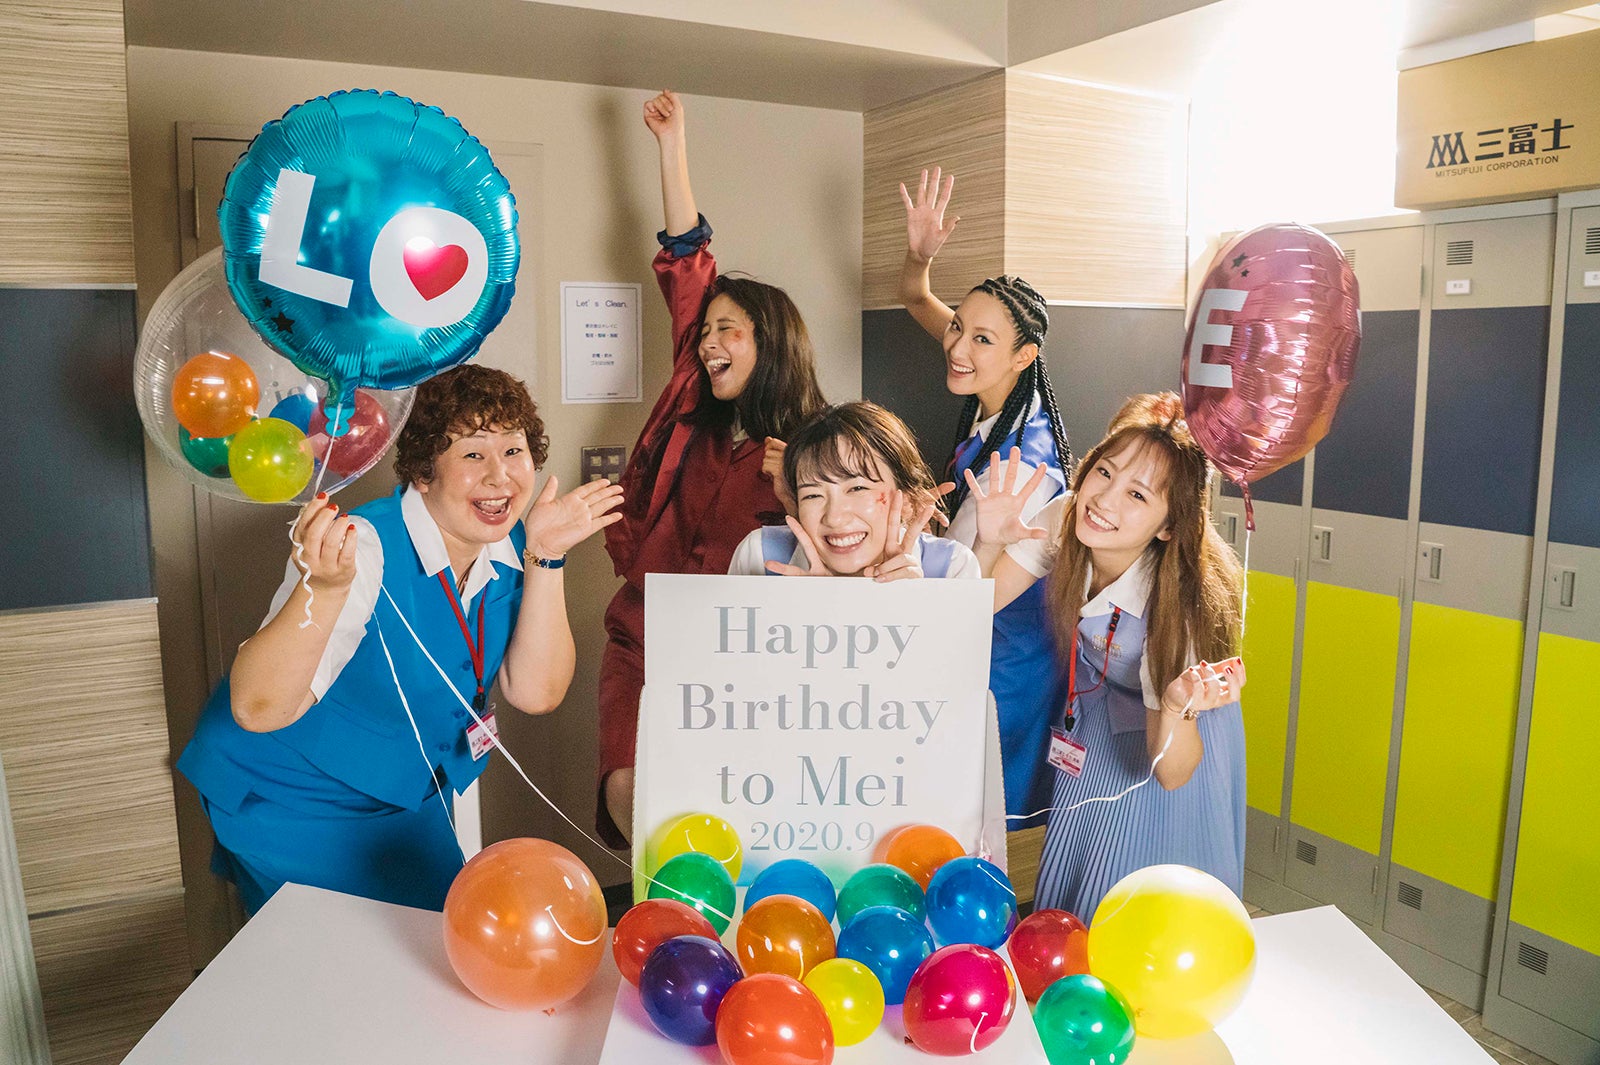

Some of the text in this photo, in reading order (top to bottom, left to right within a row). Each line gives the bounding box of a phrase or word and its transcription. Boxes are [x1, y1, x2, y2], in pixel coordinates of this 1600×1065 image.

[1435, 155, 1559, 178] MITSUFUJI CORPORATION
[1189, 288, 1249, 389] E
[713, 606, 920, 669] Happy
[677, 683, 948, 745] Birthday
[716, 755, 908, 806] to Mei
[750, 821, 875, 851] 2020.9
